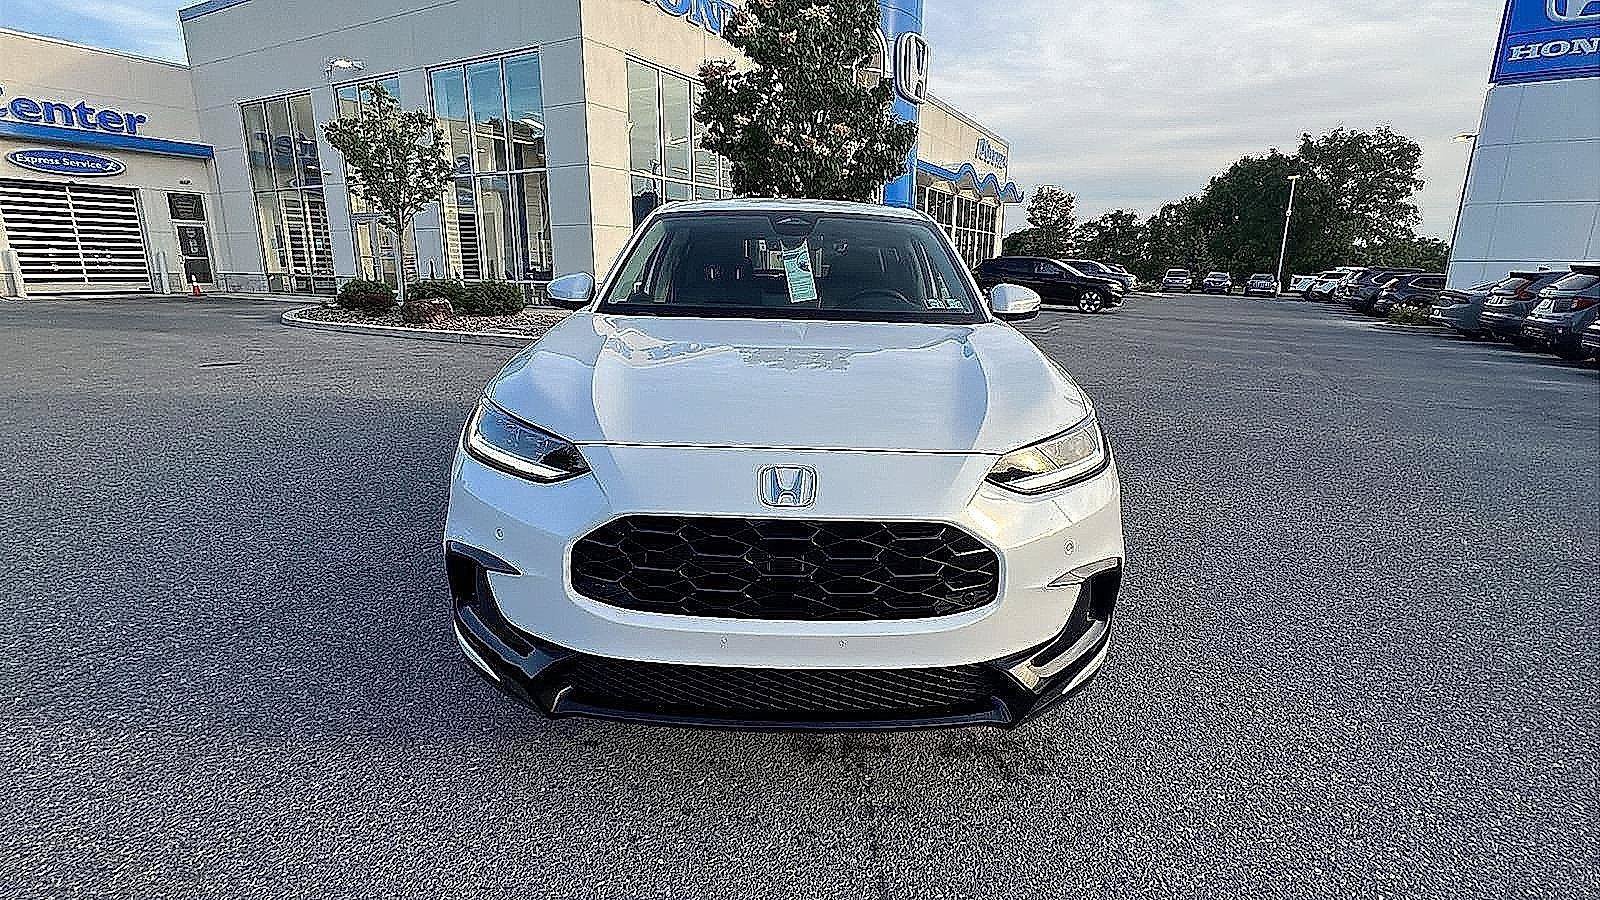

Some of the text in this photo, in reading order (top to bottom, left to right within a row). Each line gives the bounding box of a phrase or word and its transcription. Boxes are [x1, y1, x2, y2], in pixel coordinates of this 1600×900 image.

[0, 87, 147, 134] enter
[15, 153, 102, 169] Express Service
